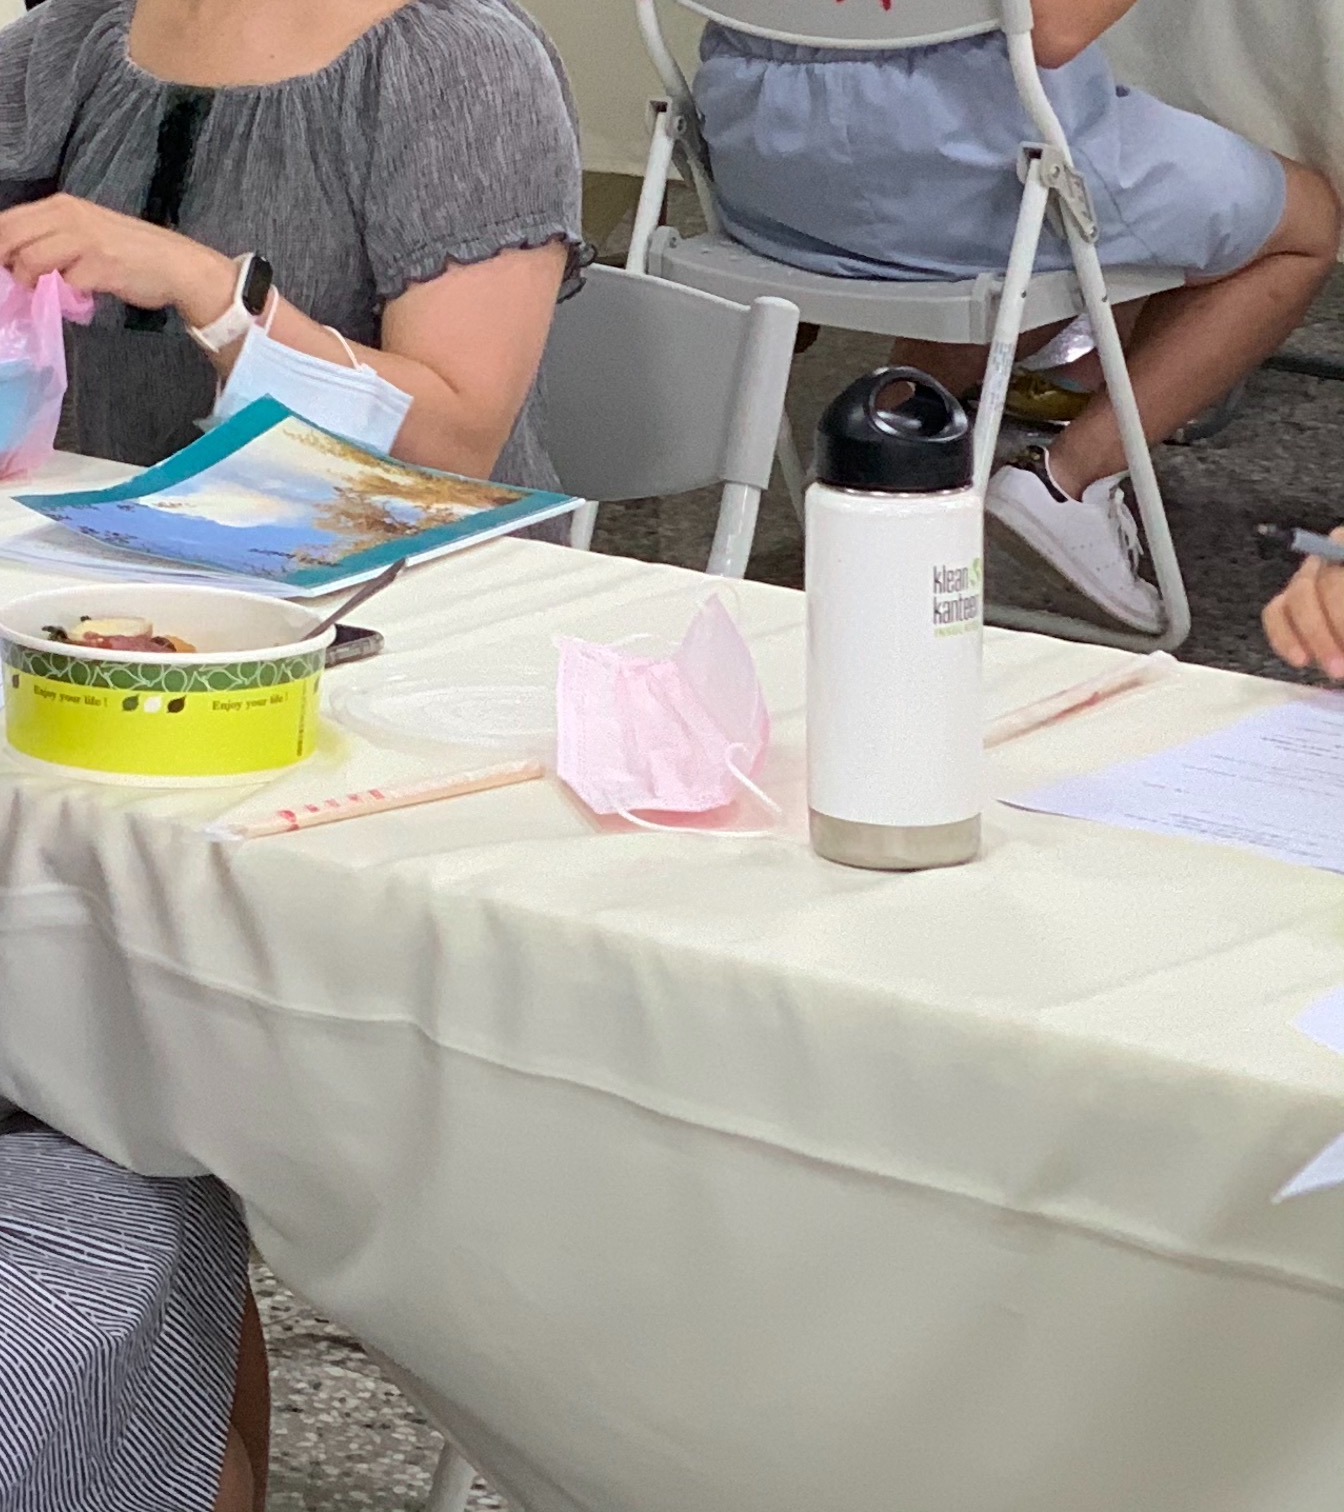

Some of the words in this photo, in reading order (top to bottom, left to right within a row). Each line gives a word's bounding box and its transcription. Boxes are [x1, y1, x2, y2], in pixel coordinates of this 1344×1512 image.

[933, 564, 969, 594] klean
[32, 684, 57, 702] Enjoy
[59, 692, 81, 705] your
[211, 698, 243, 713] Enjoy
[245, 698, 268, 711] your
